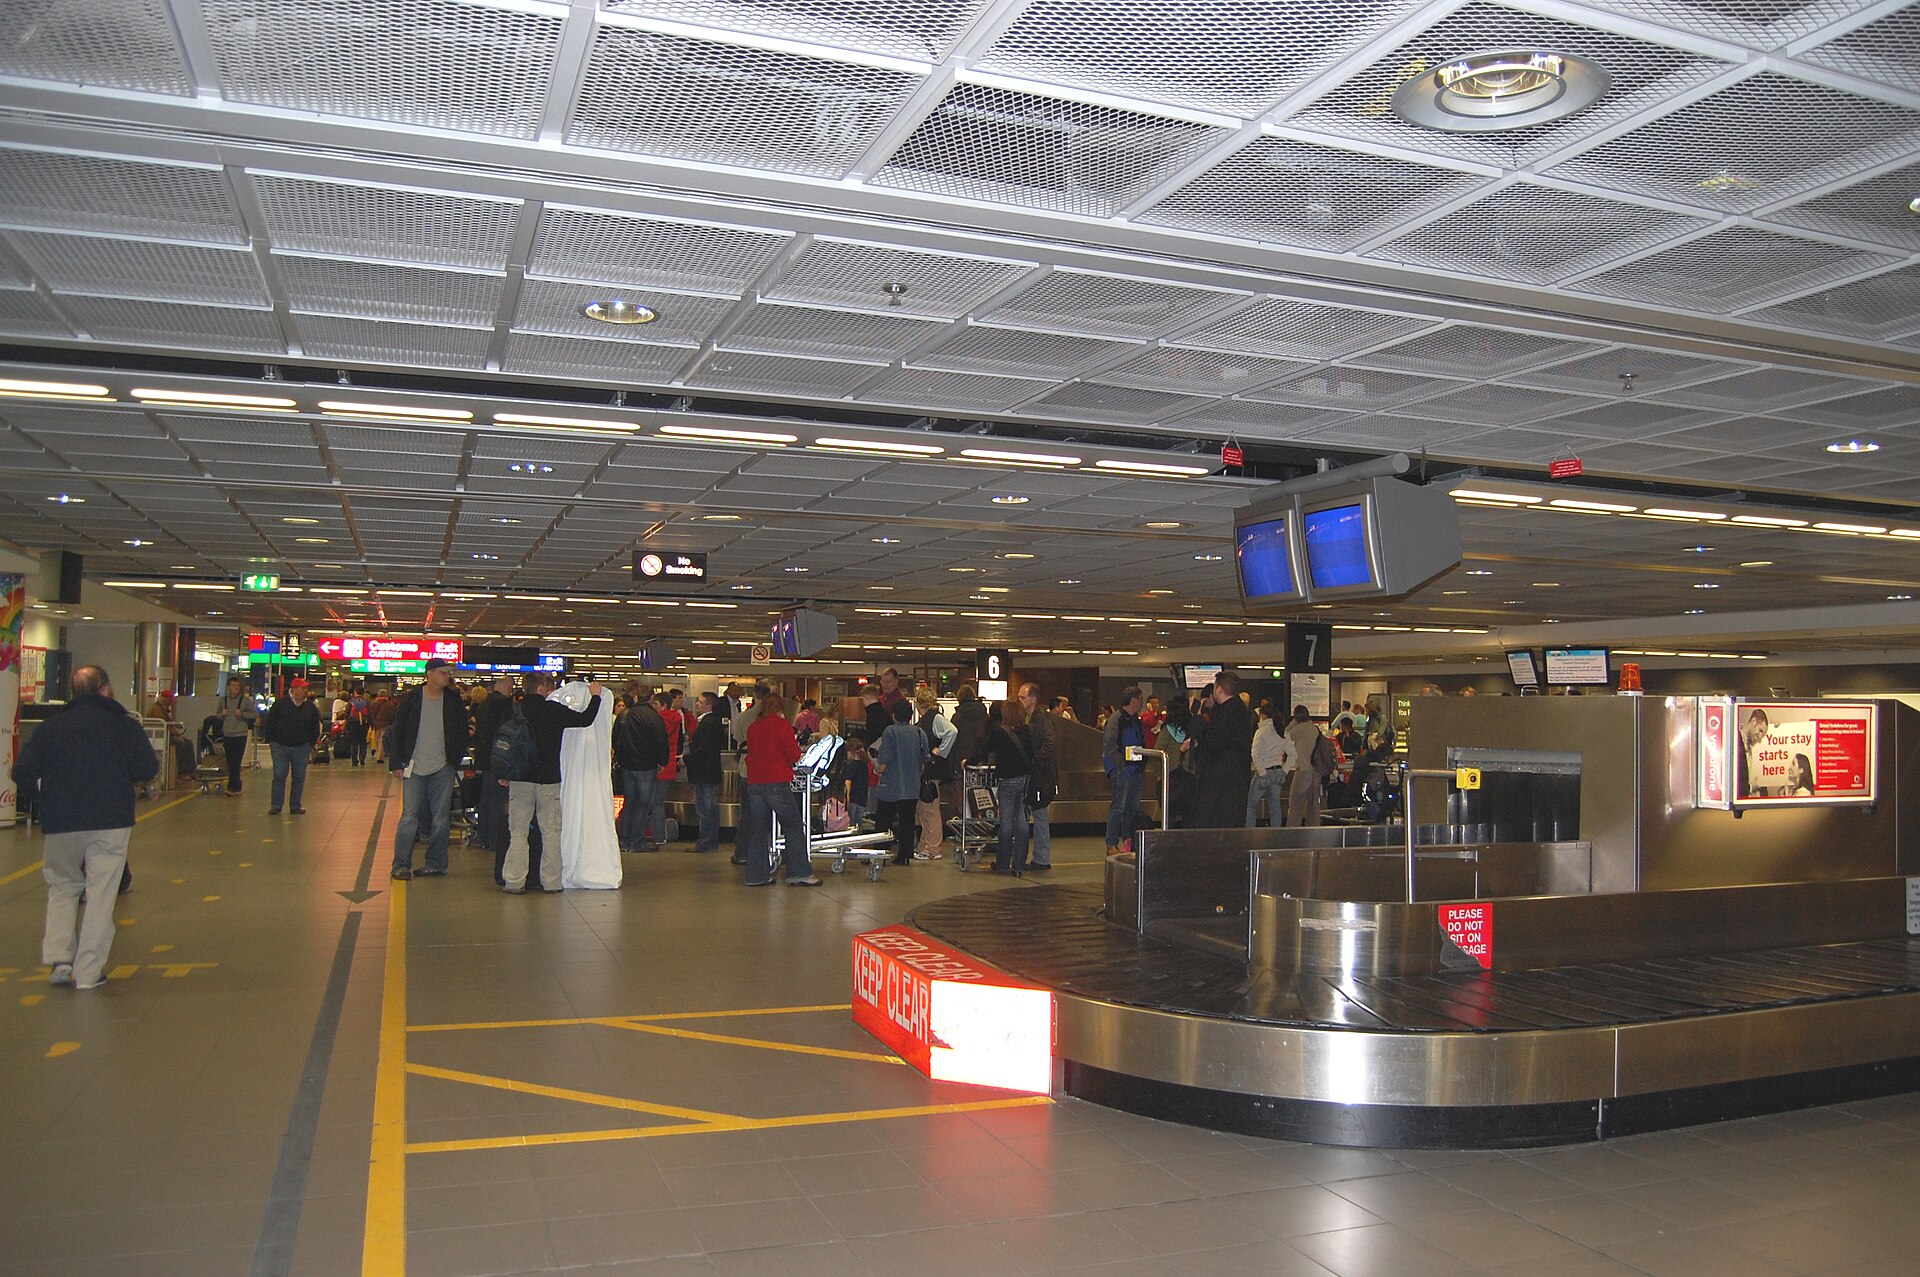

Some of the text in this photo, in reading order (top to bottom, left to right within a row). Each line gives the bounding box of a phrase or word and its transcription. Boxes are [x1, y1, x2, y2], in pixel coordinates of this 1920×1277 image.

[677, 557, 691, 565] No
[665, 565, 703, 576] Smoking
[368, 640, 459, 653] Customs Exit
[1305, 634, 1318, 667] 7
[988, 655, 1000, 679] 6
[1766, 734, 1812, 747] Your stay
[1759, 749, 1788, 761] starts
[1763, 764, 1785, 776] here
[1448, 908, 1483, 920] PLEASE
[1447, 920, 1483, 932] DO NOT
[1450, 932, 1481, 943] SIT ON
[858, 932, 983, 980] KEEP CLEAR
[853, 941, 929, 1045] KEEP CLEAR
